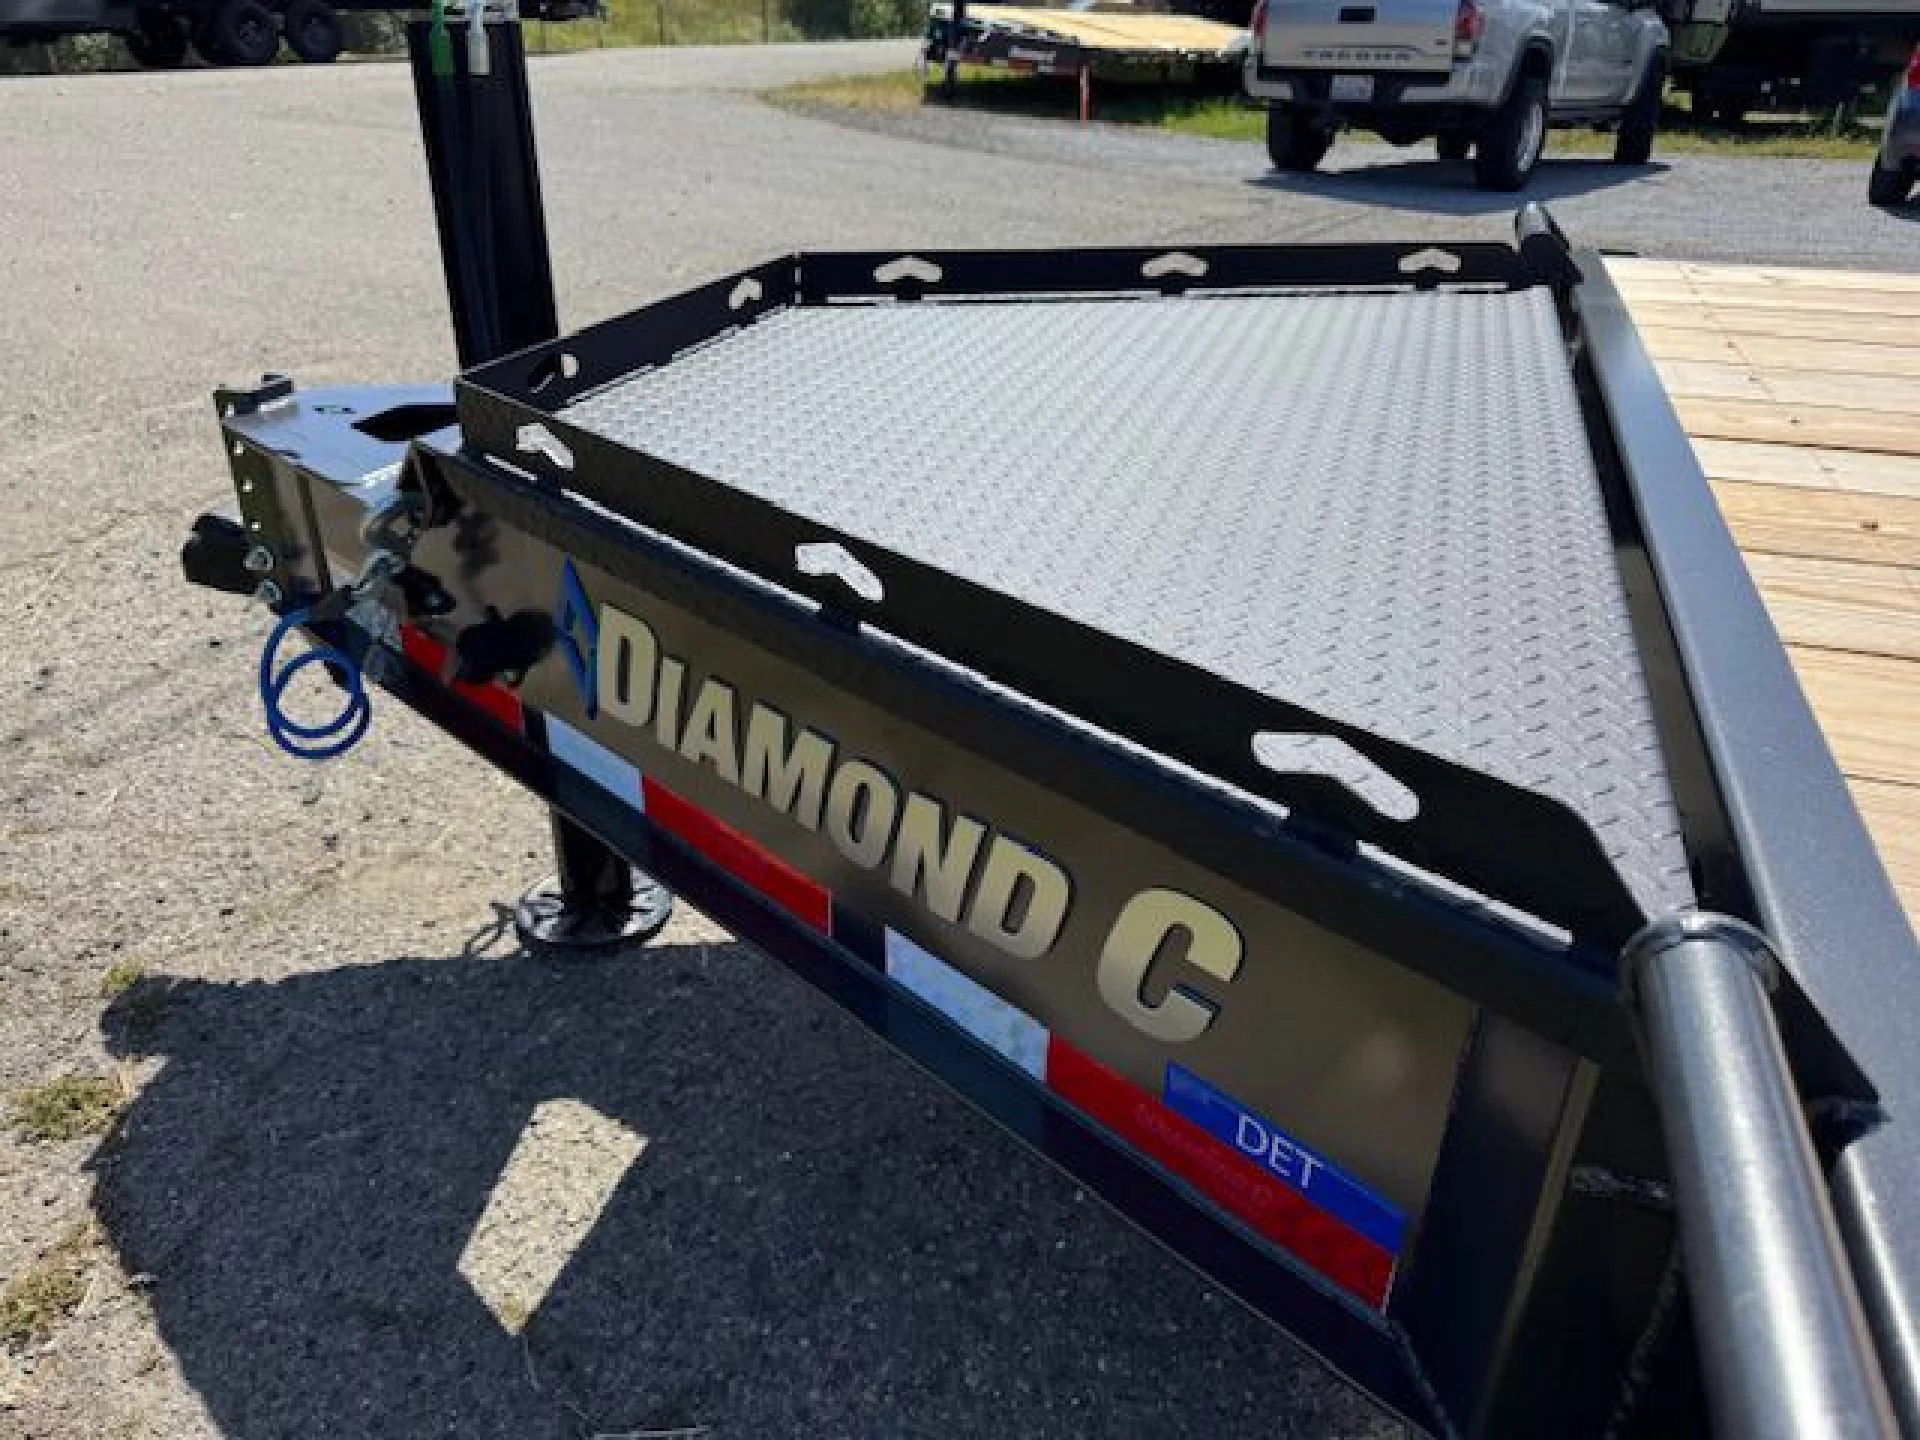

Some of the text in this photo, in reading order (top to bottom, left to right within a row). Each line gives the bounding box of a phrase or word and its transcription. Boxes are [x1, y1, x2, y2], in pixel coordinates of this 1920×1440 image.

[599, 603, 1244, 1042] DIAMOND C
[1236, 1113, 1324, 1188] DET
